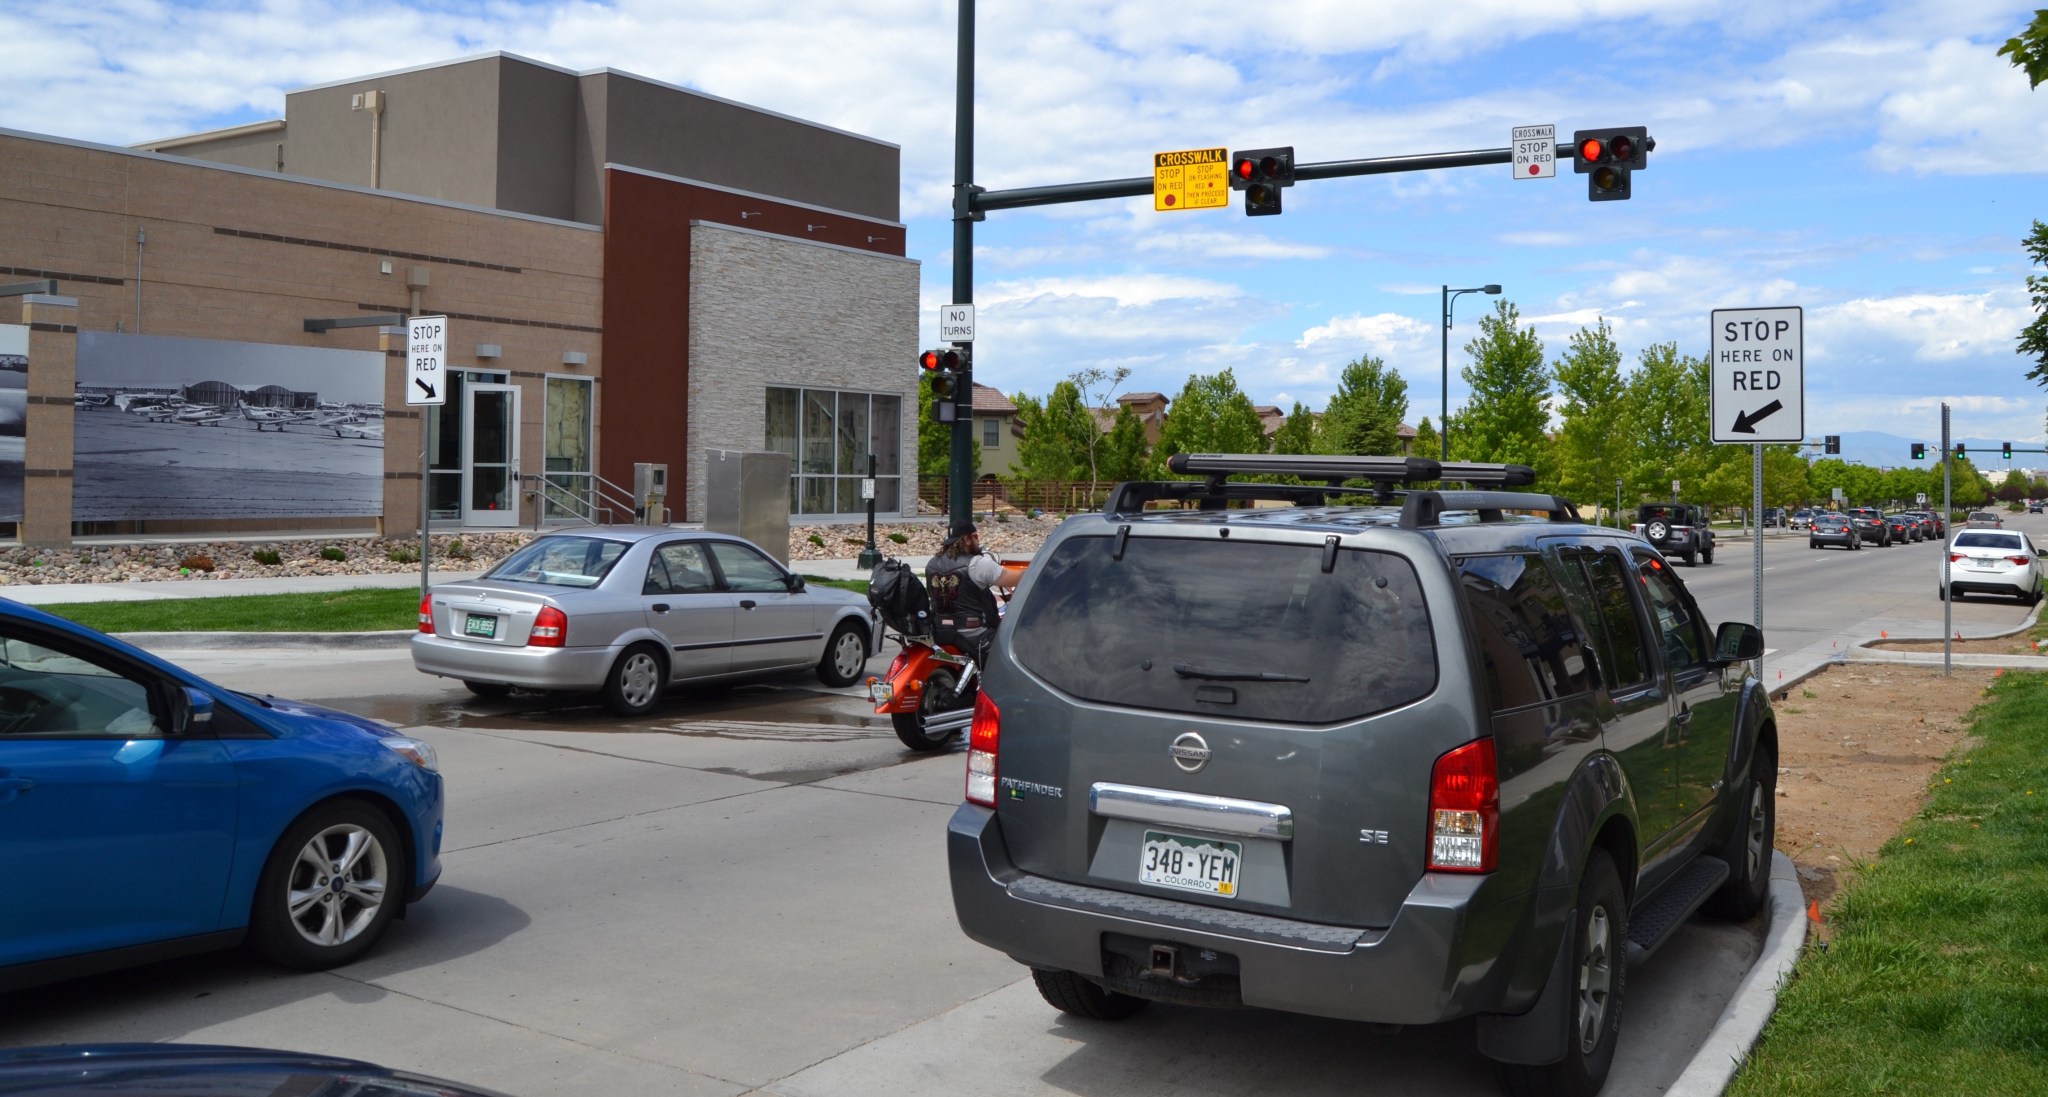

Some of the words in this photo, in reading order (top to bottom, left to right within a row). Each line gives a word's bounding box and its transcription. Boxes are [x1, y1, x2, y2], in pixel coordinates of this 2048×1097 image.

[1514, 127, 1553, 138] CROSSWALK
[1520, 142, 1548, 153] STOP
[1160, 149, 1222, 166] CROSSWALK
[1516, 155, 1529, 164] ON
[1533, 153, 1552, 163] RED
[1160, 169, 1181, 179] STOP
[1197, 165, 1214, 174] STOP
[1158, 183, 1167, 191] ON
[1170, 181, 1183, 190] RED
[950, 311, 966, 321] NO
[413, 325, 441, 340] STOP
[943, 326, 972, 336] TURNS
[1724, 320, 1790, 342] STOP
[411, 344, 429, 353] HERE
[433, 343, 442, 352] ON
[1721, 349, 1763, 362] HERE
[1772, 348, 1793, 361] ON
[416, 357, 437, 371] RED
[1733, 370, 1781, 391] RED
[1172, 748, 1206, 758] NISSAN
[1001, 776, 1063, 798] PATHFINDER
[1359, 829, 1389, 844] SE
[1164, 875, 1212, 890] COLORADO
